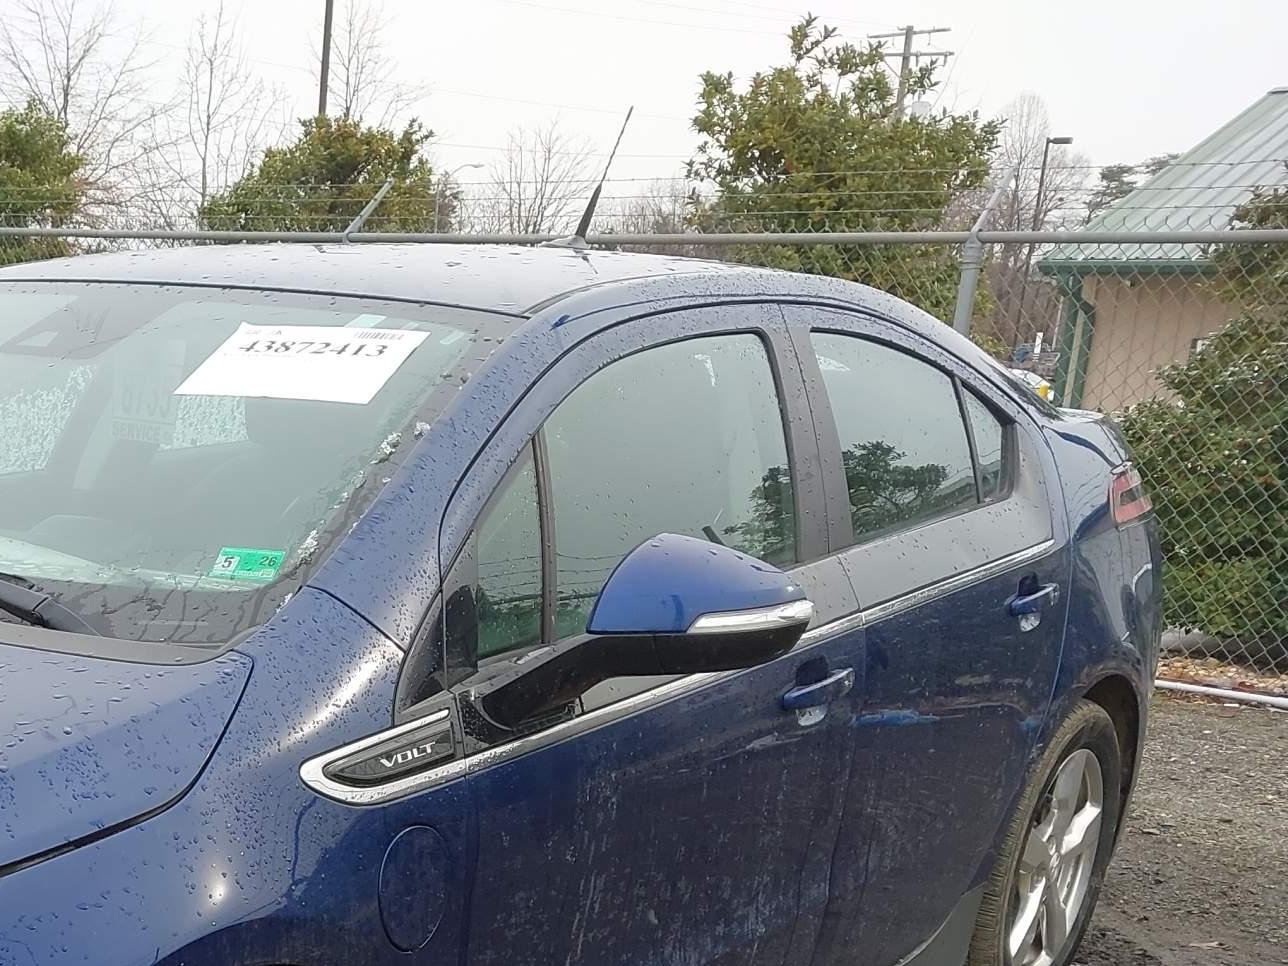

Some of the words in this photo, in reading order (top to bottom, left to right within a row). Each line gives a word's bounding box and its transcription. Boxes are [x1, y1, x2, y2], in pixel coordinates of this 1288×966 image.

[239, 340, 389, 357] 43872413
[221, 556, 235, 569] 5
[258, 555, 278, 567] 26
[380, 741, 436, 768] VOLT
